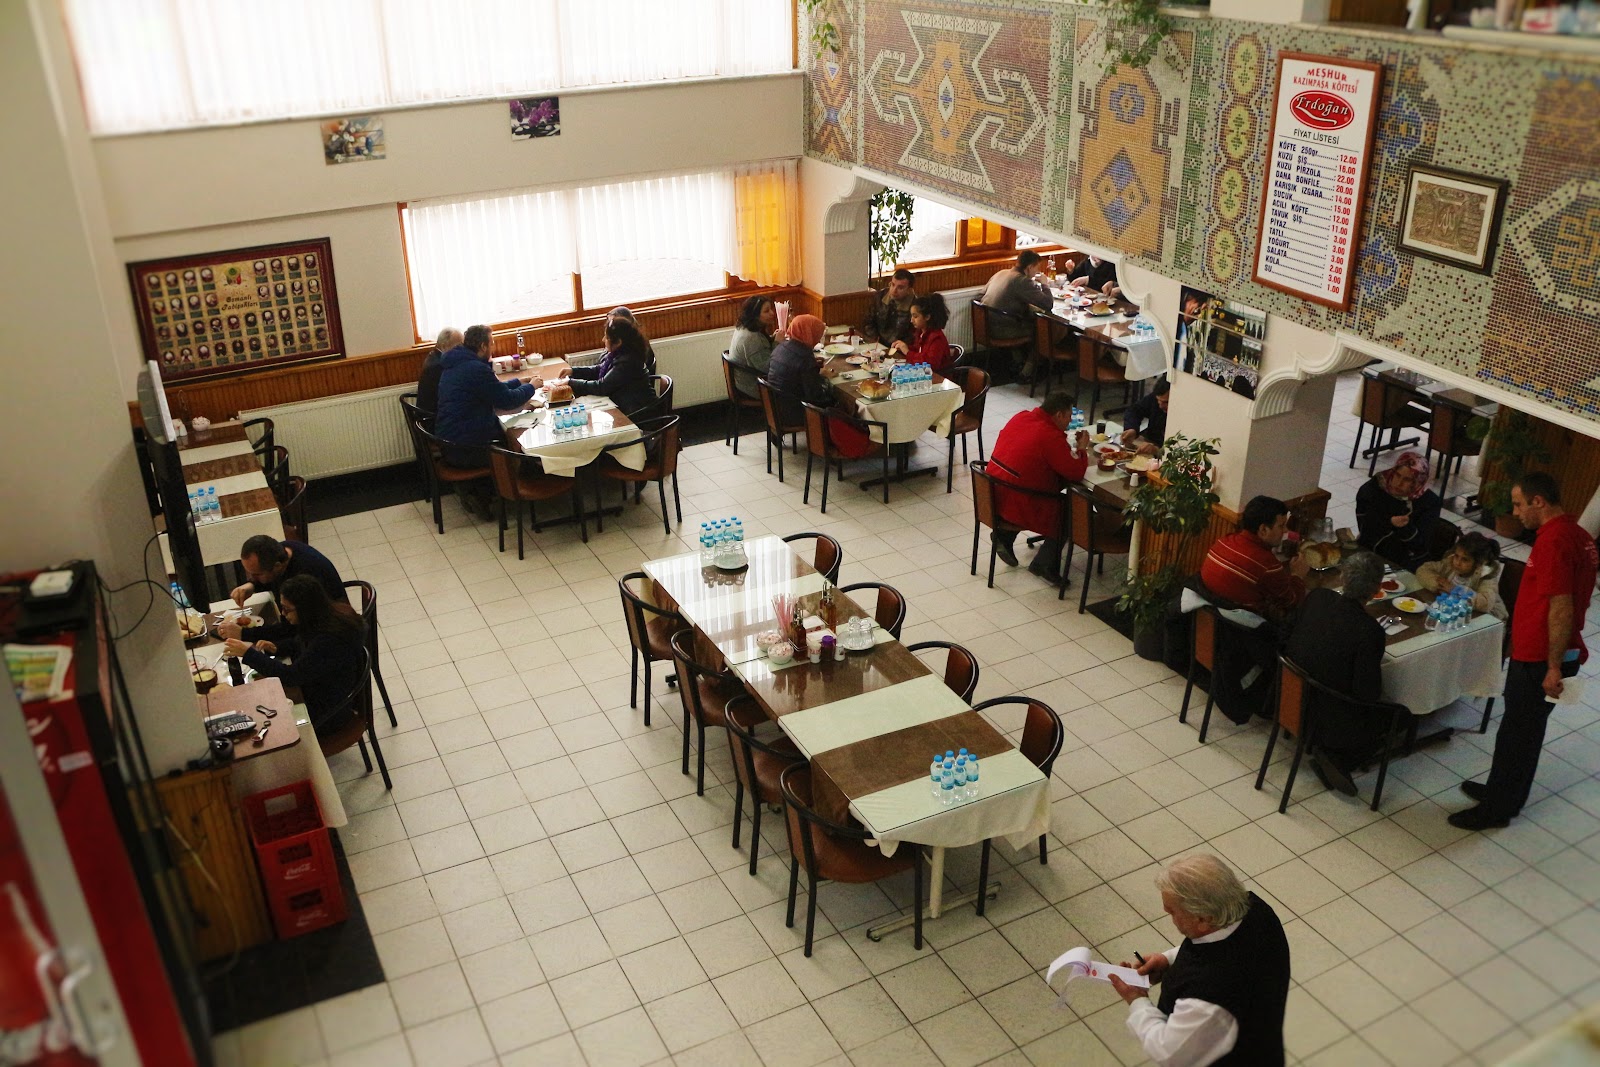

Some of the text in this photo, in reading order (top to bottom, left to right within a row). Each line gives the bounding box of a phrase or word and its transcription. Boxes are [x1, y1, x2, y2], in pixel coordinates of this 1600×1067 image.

[1307, 68, 1347, 81] MEŞHUR
[1293, 76, 1359, 94] KAZIMPAŞA KÖFTESİ
[1296, 96, 1349, 124] Erdoğan
[1293, 128, 1340, 145] FİYAT LİSTESİ
[1278, 151, 1293, 161] KUZU
[1279, 141, 1296, 152] KÖFTE
[1340, 154, 1357, 164] 12.00
[1276, 160, 1355, 185] KUZU PİRZOLA 22.00
[1296, 175, 1320, 188] BONFİLE
[1336, 184, 1353, 195] 20.00
[1273, 189, 1293, 200] SUCUK
[1271, 208, 1288, 219] TAVUK
[1331, 225, 1348, 235] 11.00
[1291, 203, 1309, 214] KÖFTE
[1333, 215, 1349, 225] 12.00
[1333, 235, 1347, 245] 3.00
[1332, 245, 1345, 255] 3.00
[1265, 255, 1280, 266] KOLA
[1266, 245, 1343, 275] SALATA 2.00
